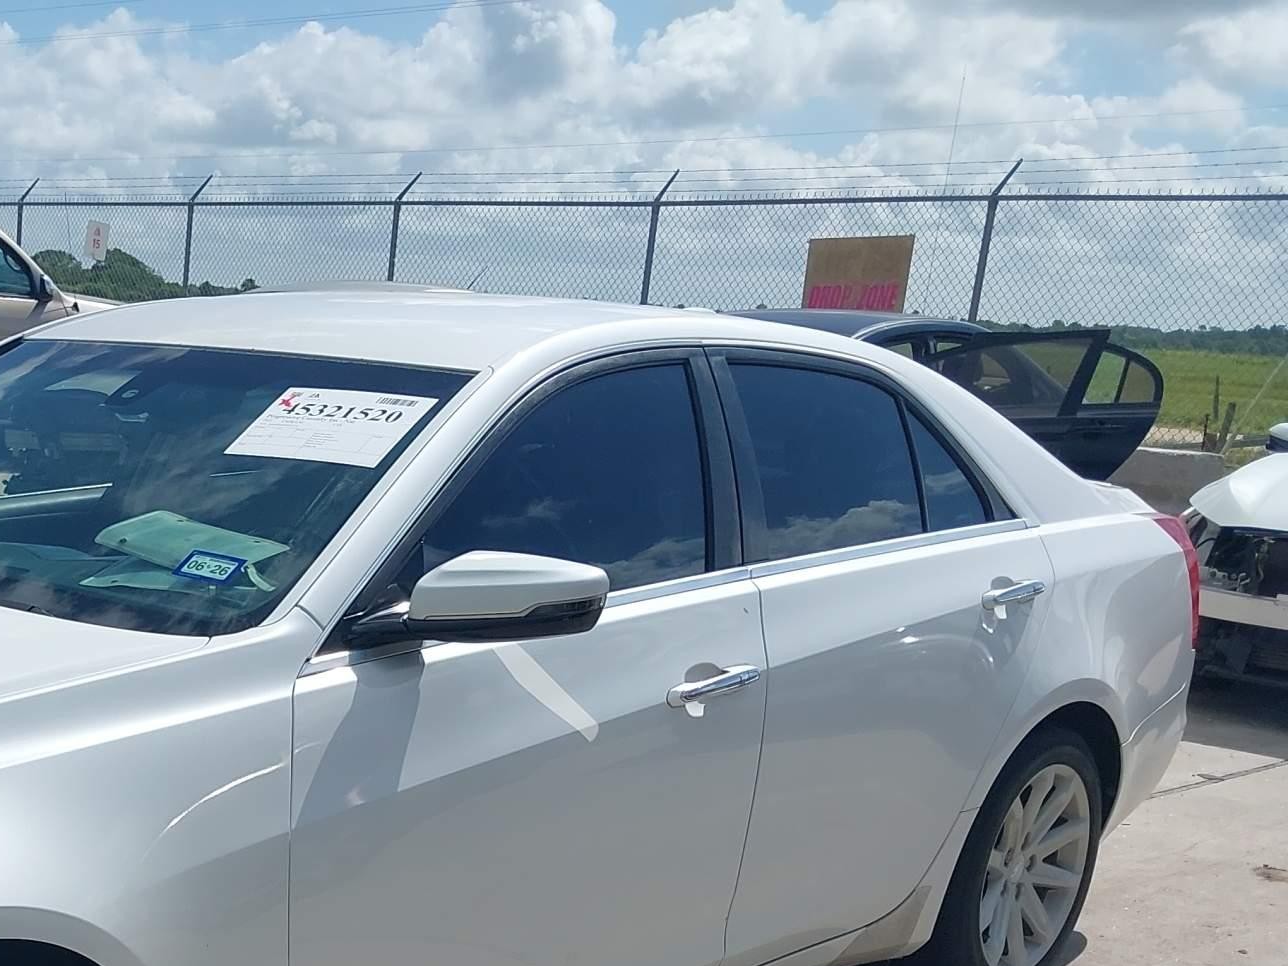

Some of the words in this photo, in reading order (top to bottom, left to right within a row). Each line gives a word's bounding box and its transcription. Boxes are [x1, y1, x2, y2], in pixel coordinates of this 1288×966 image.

[92, 239, 101, 249] 15
[281, 402, 403, 424] 45321520
[187, 560, 207, 571] 06
[209, 564, 231, 576] 26
